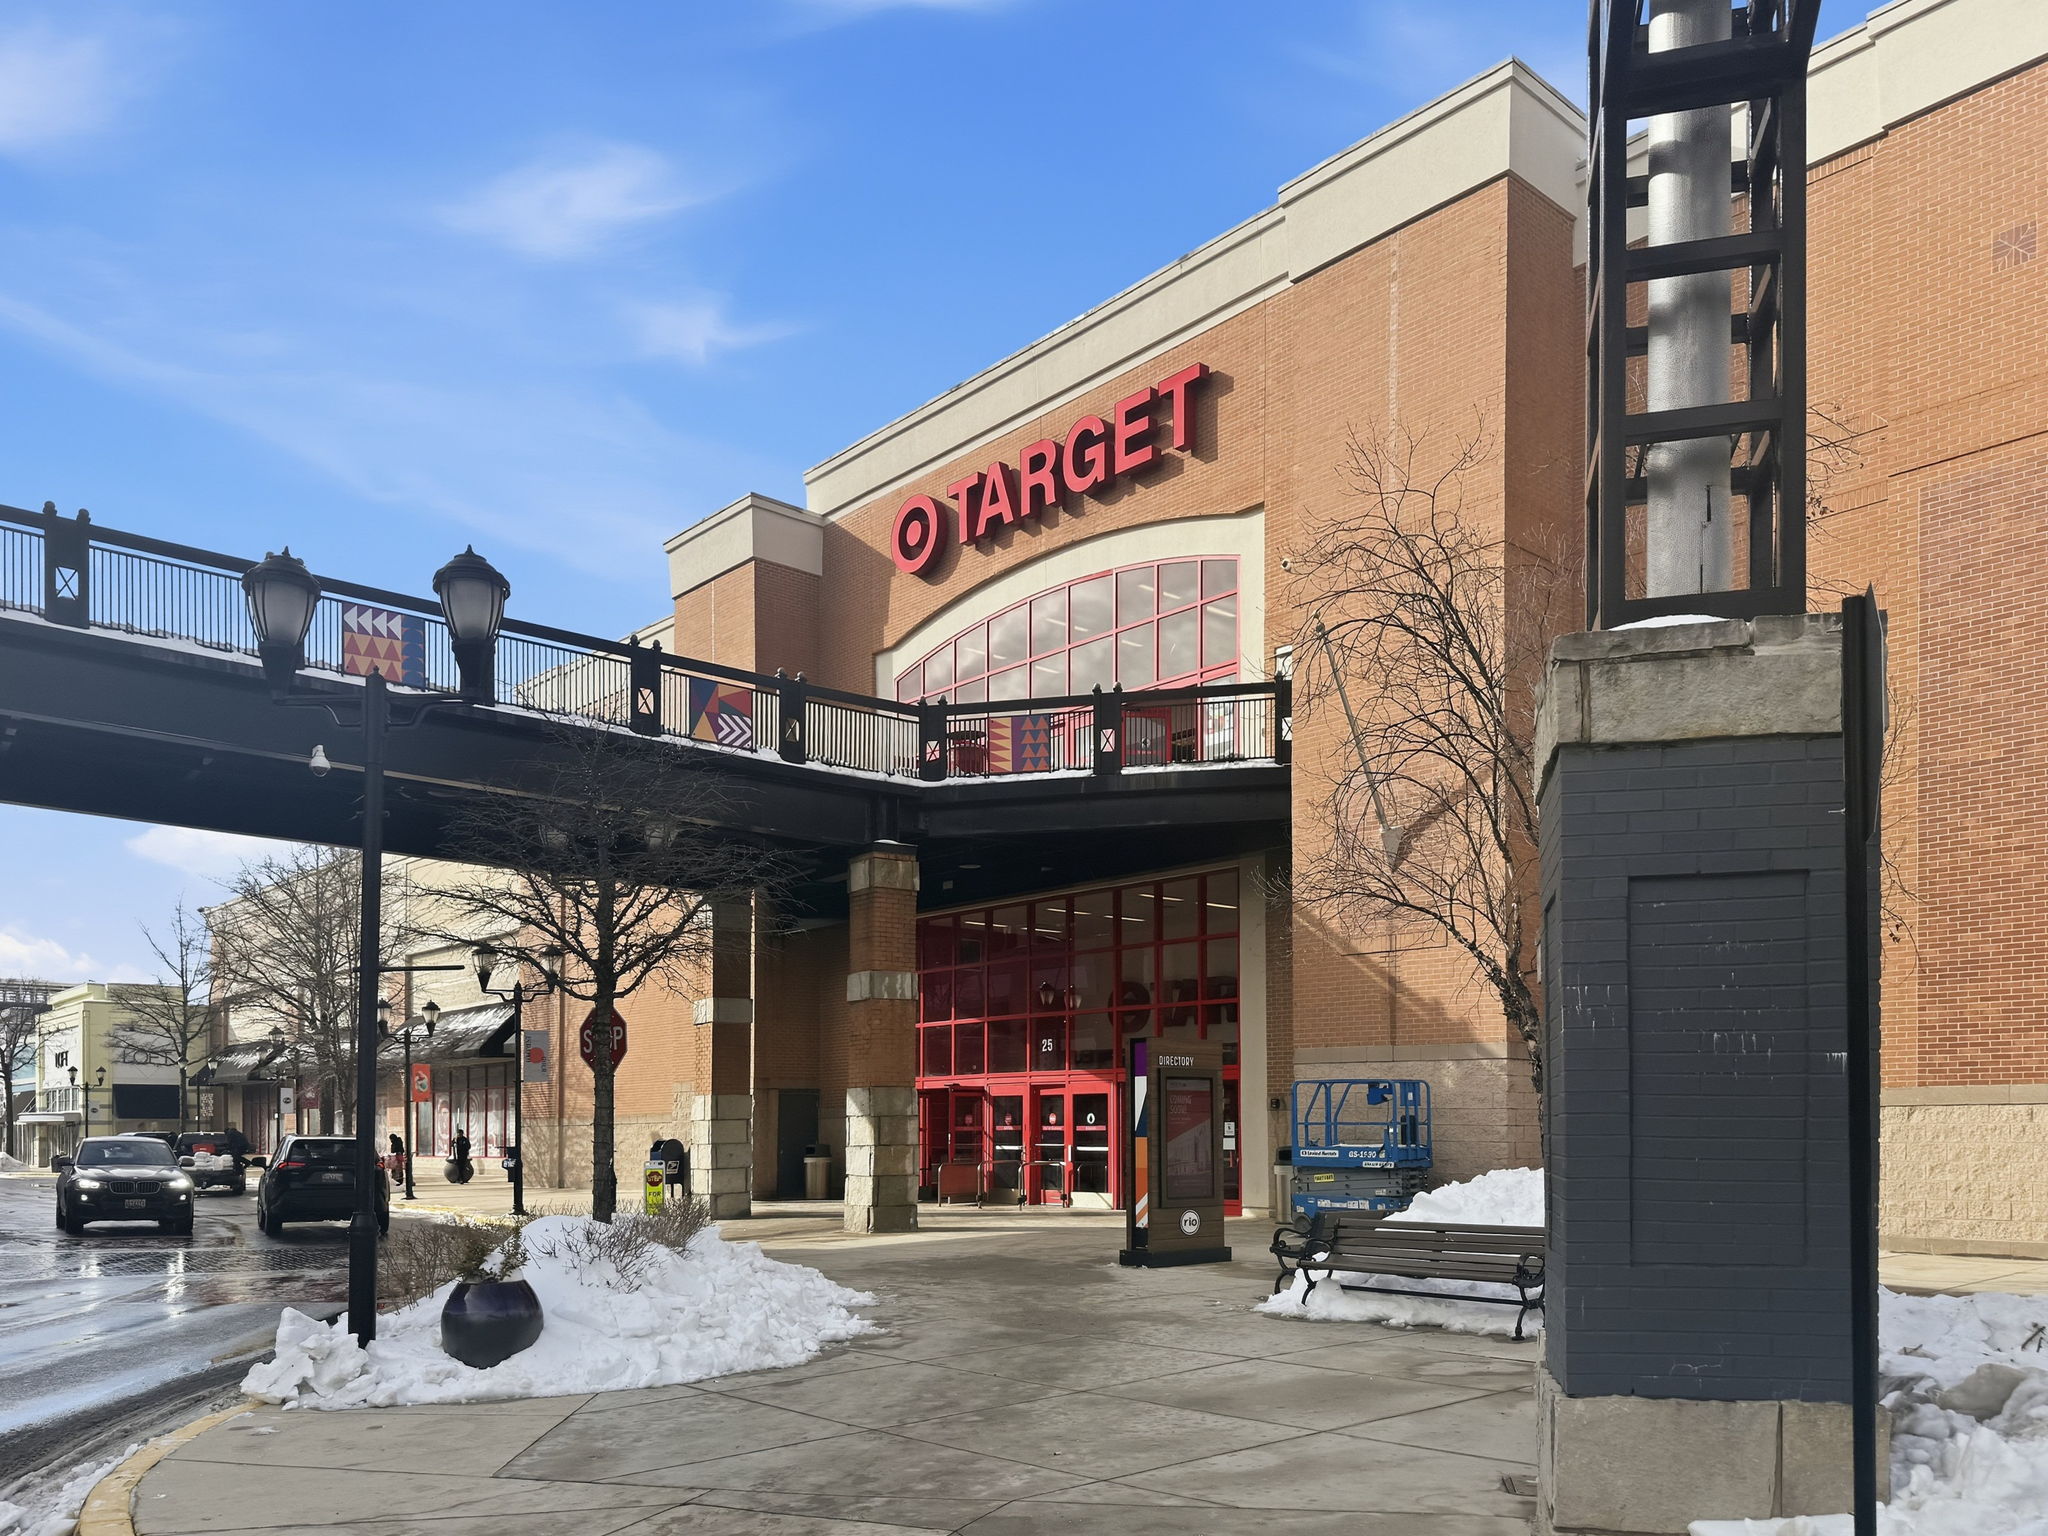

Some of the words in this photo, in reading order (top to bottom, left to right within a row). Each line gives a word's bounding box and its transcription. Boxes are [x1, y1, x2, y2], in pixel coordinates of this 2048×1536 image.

[947, 362, 1209, 546] TARGET
[583, 1026, 623, 1053] SP
[1042, 1038, 1053, 1051] 25
[1158, 1055, 1194, 1066] DIRECTORY
[1184, 1216, 1198, 1227] rio
